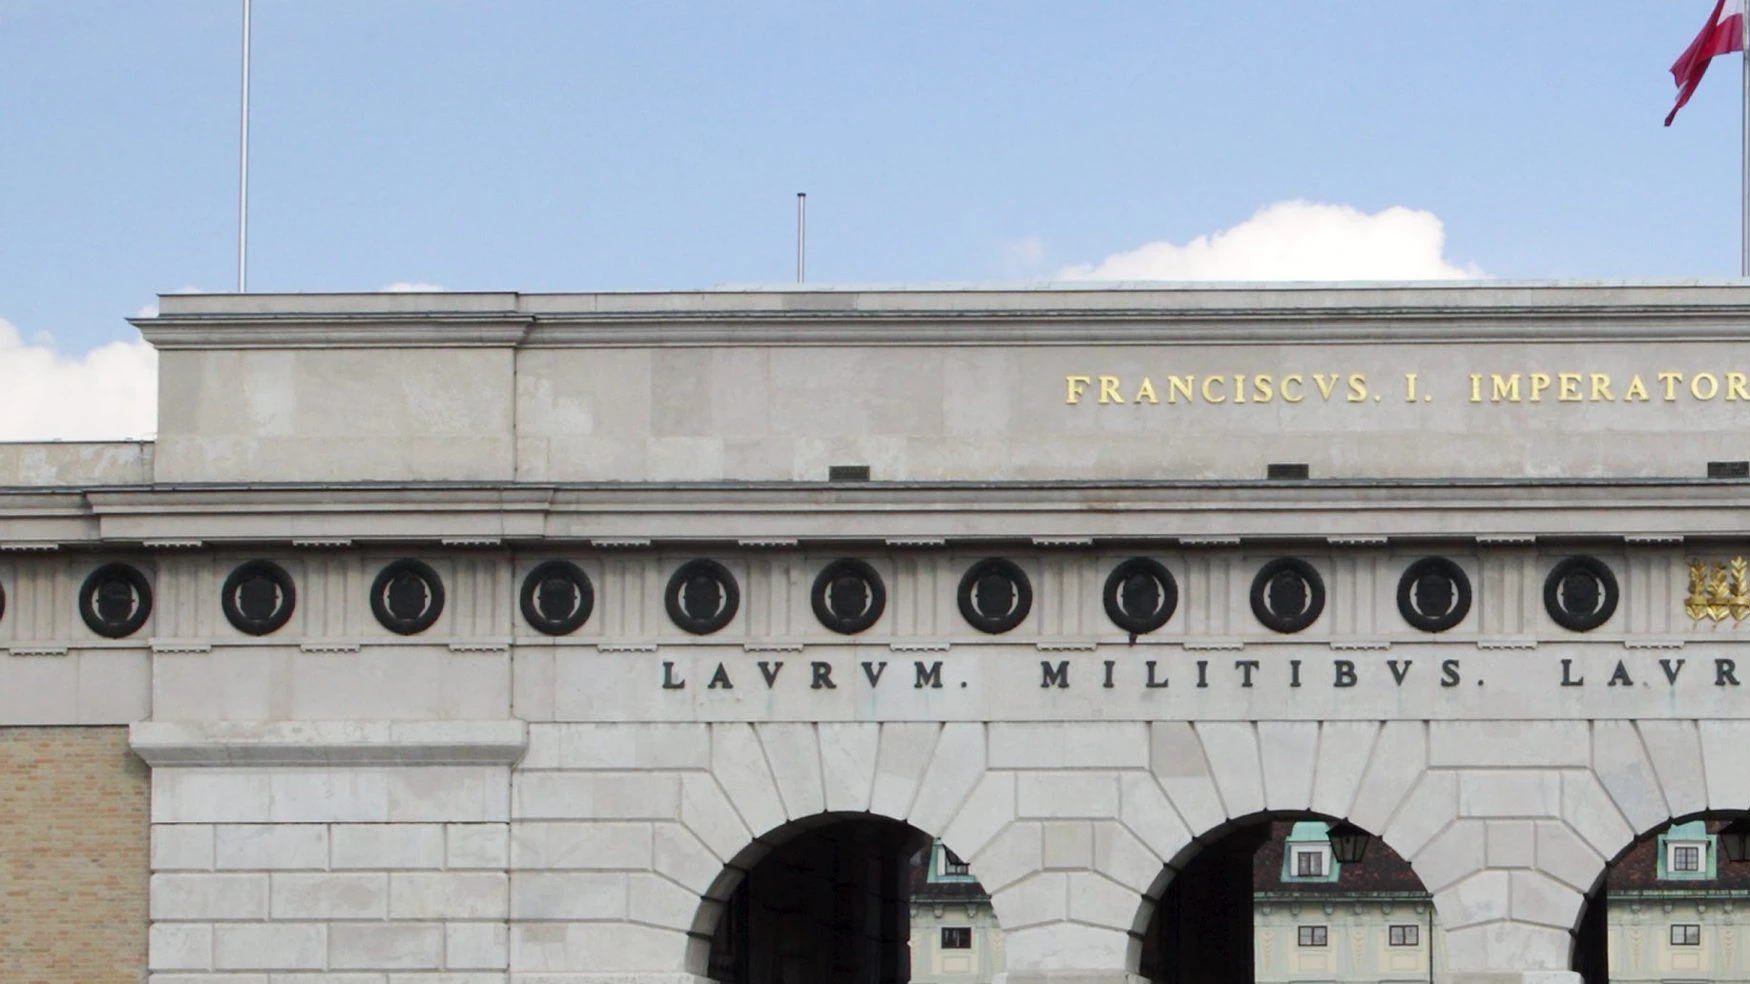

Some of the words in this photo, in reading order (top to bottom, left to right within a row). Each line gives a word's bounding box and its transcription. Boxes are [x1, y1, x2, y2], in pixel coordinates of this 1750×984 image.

[1065, 373, 1381, 404] FRANCISCVS.
[1404, 372, 1432, 402] I.
[661, 660, 968, 690] LAVRVM.
[1039, 659, 1485, 689] MILITIBVS.
